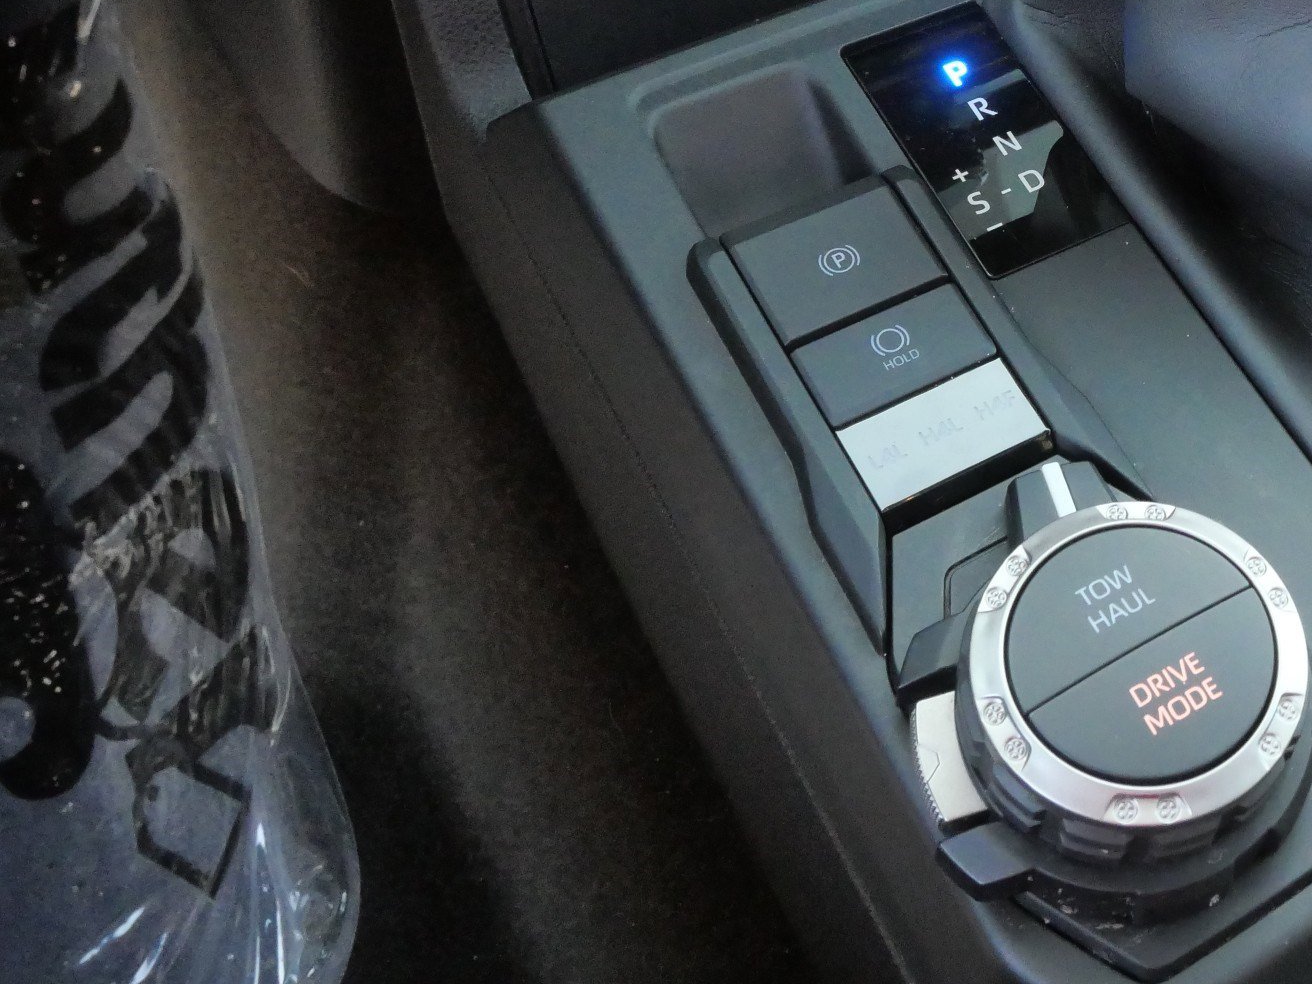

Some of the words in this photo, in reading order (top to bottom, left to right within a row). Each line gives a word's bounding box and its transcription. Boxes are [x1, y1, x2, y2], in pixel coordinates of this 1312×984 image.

[942, 59, 969, 88] P
[967, 97, 999, 121] R
[992, 130, 1023, 156] N
[966, 190, 991, 215] S
[1017, 169, 1045, 193] D
[882, 348, 920, 371] HOLD
[1075, 565, 1133, 606] TOW
[1087, 588, 1156, 633] HAUL
[1129, 651, 1205, 708] DRIVE
[1143, 677, 1224, 736] MODE
